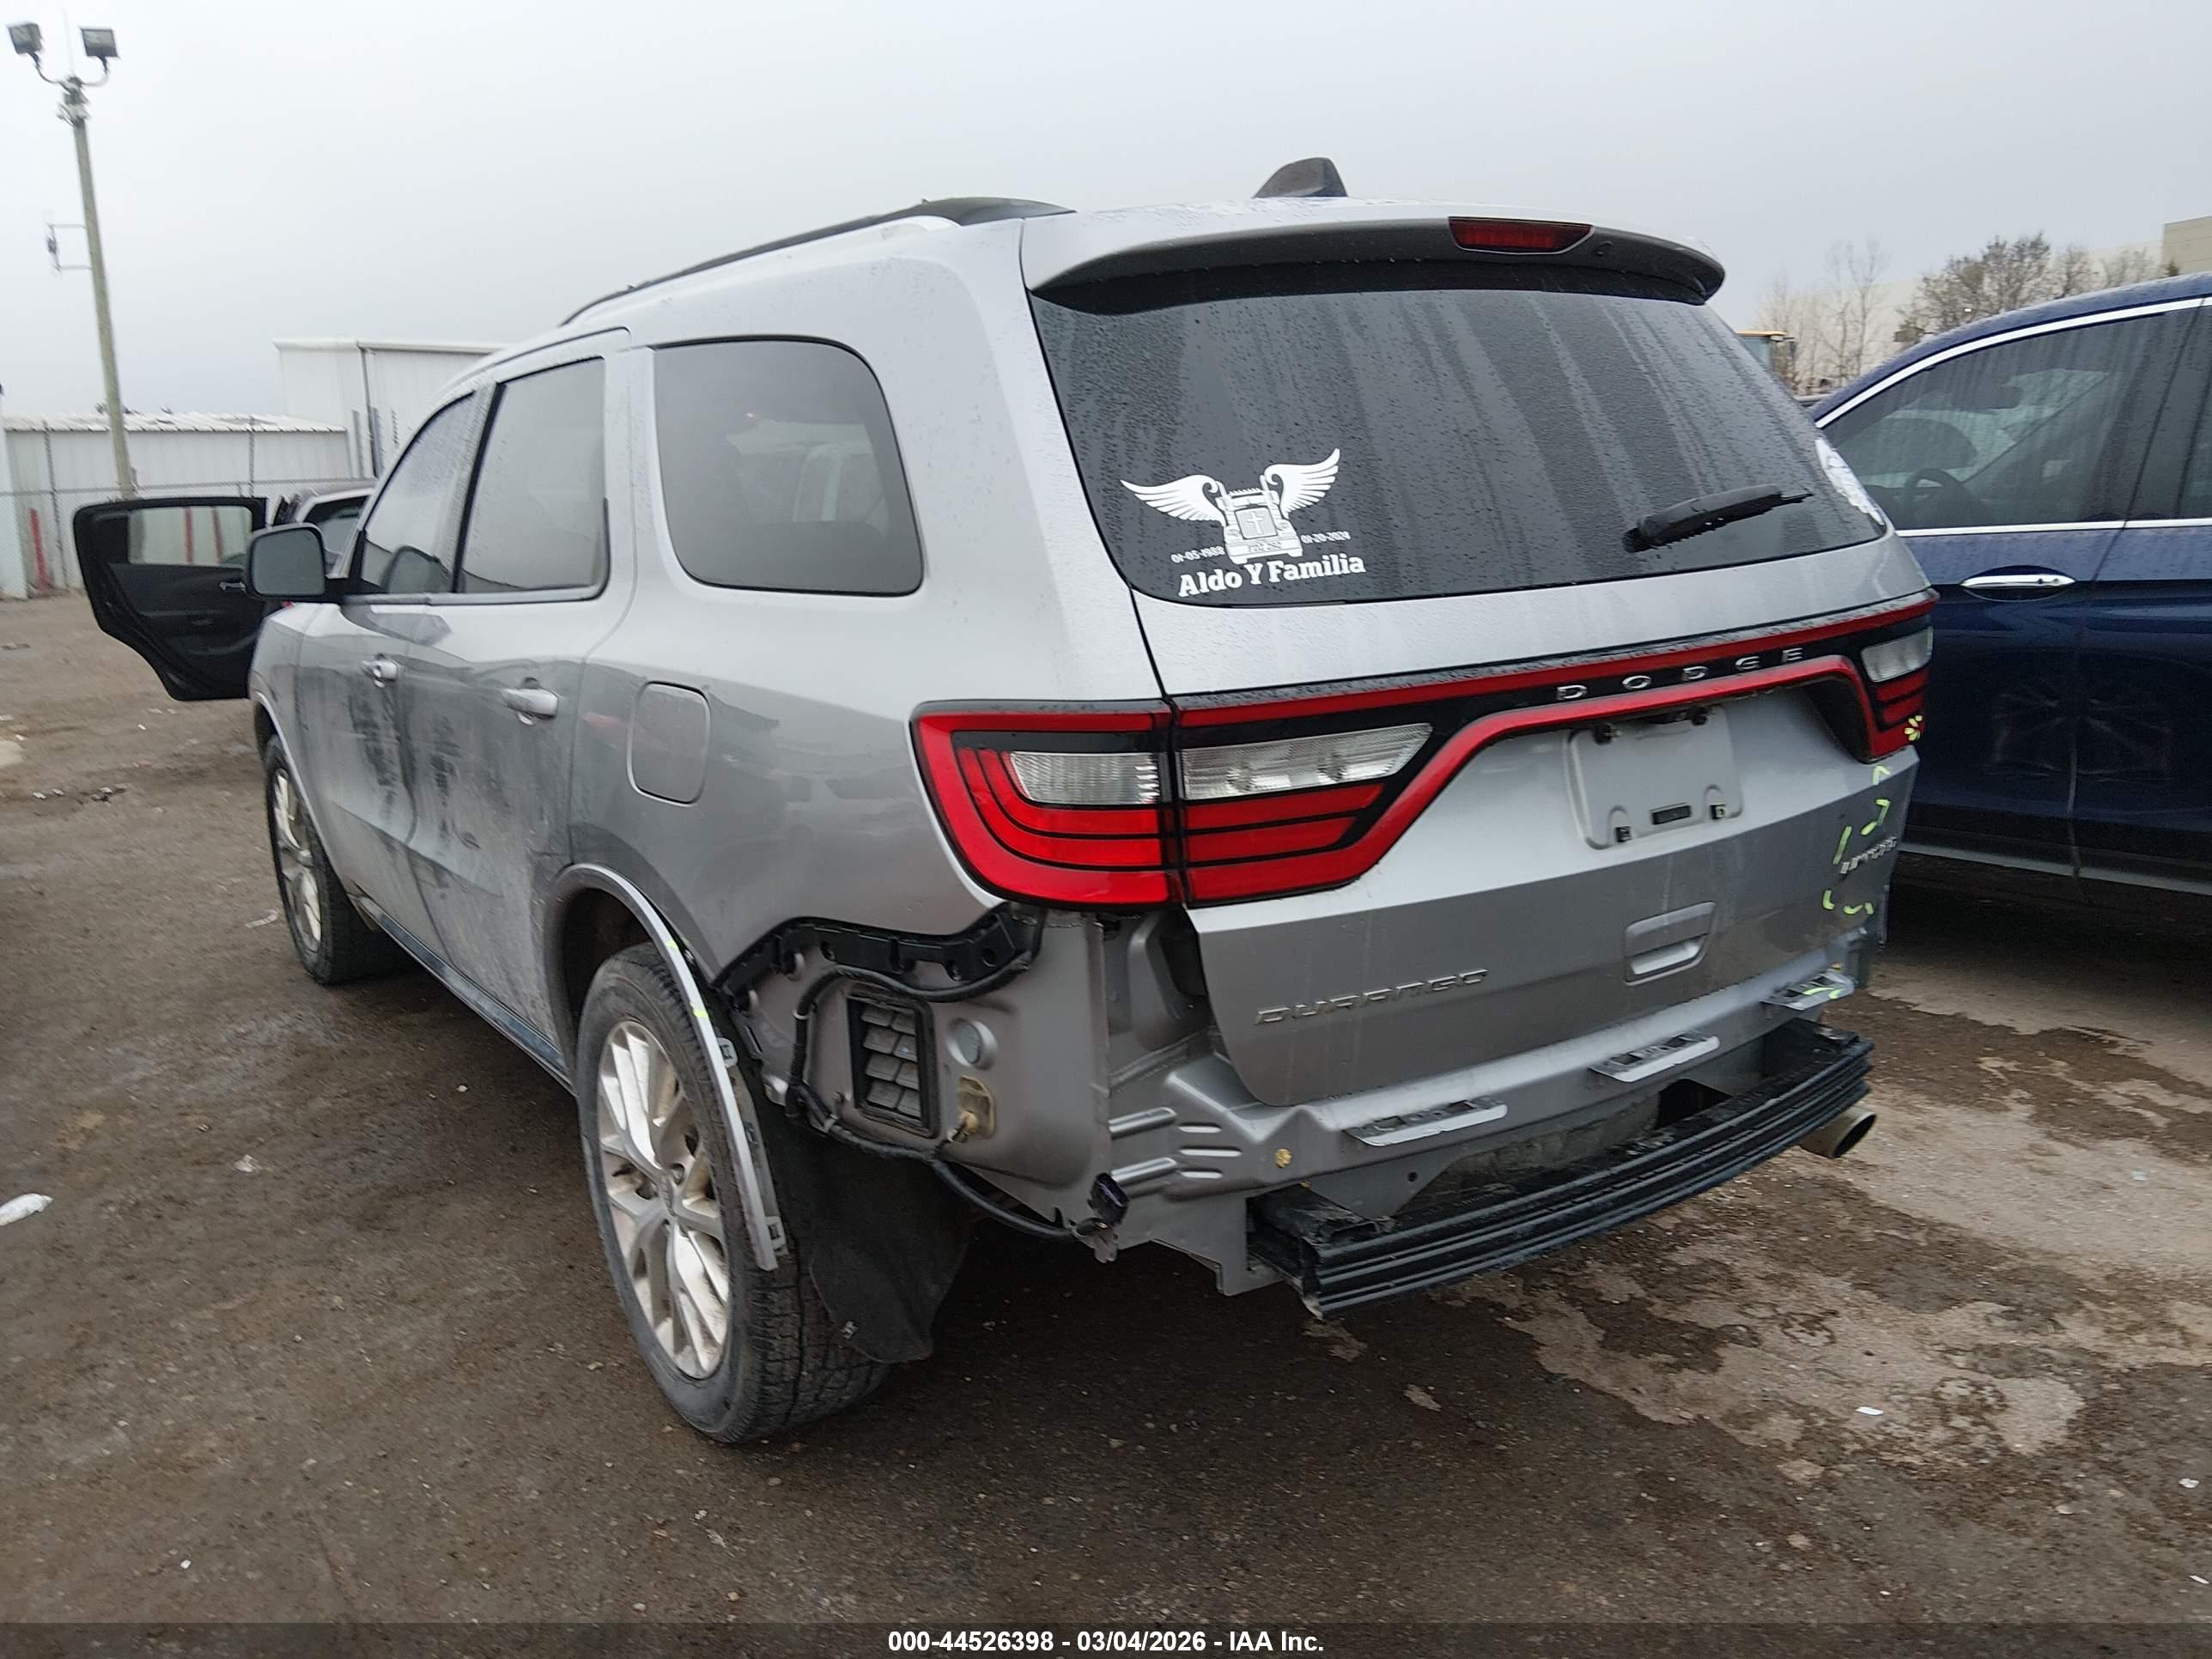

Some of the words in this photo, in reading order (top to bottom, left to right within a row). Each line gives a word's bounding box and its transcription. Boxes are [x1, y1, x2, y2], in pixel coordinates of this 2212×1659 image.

[1178, 568, 1243, 597] Aldo
[1244, 562, 1263, 585] Y
[1267, 553, 1366, 583] Familia
[1556, 647, 1804, 700] DODGE
[1253, 968, 1489, 1026] DURANGO
